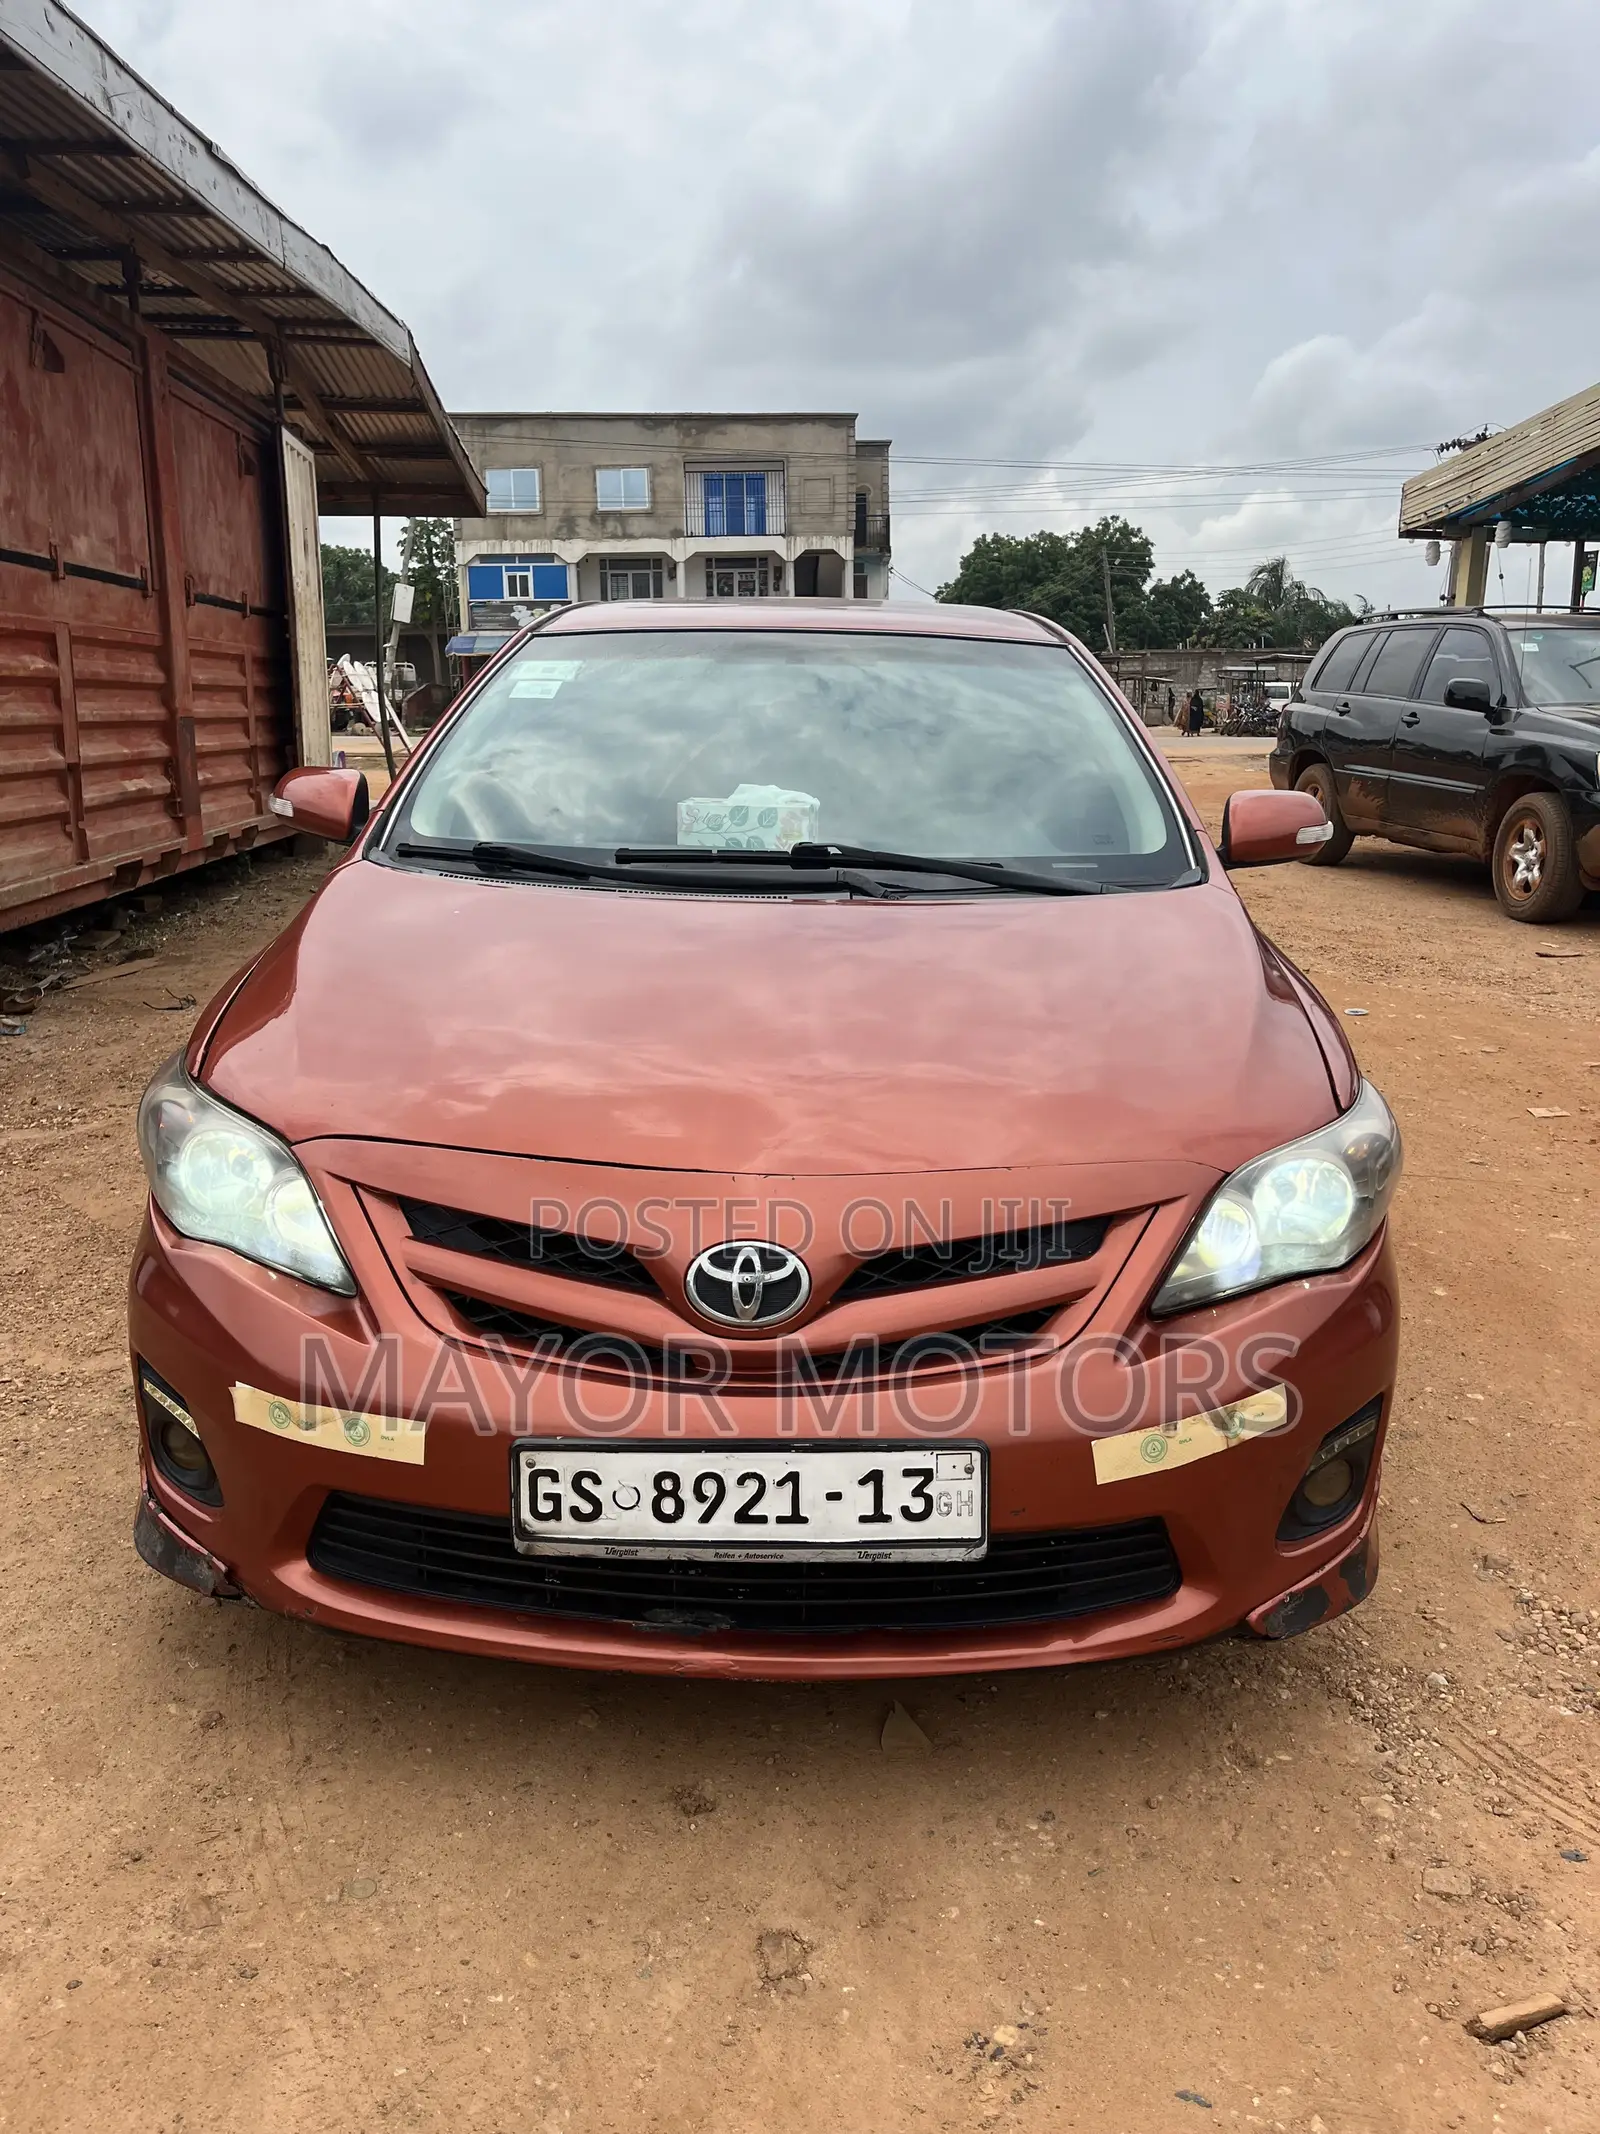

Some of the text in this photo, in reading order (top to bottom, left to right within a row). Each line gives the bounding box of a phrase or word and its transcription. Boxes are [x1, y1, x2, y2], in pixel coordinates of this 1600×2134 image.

[527, 1467, 603, 1523] GS
[936, 1490, 974, 1518] GH
[744, 1552, 784, 1560] Autoservice
